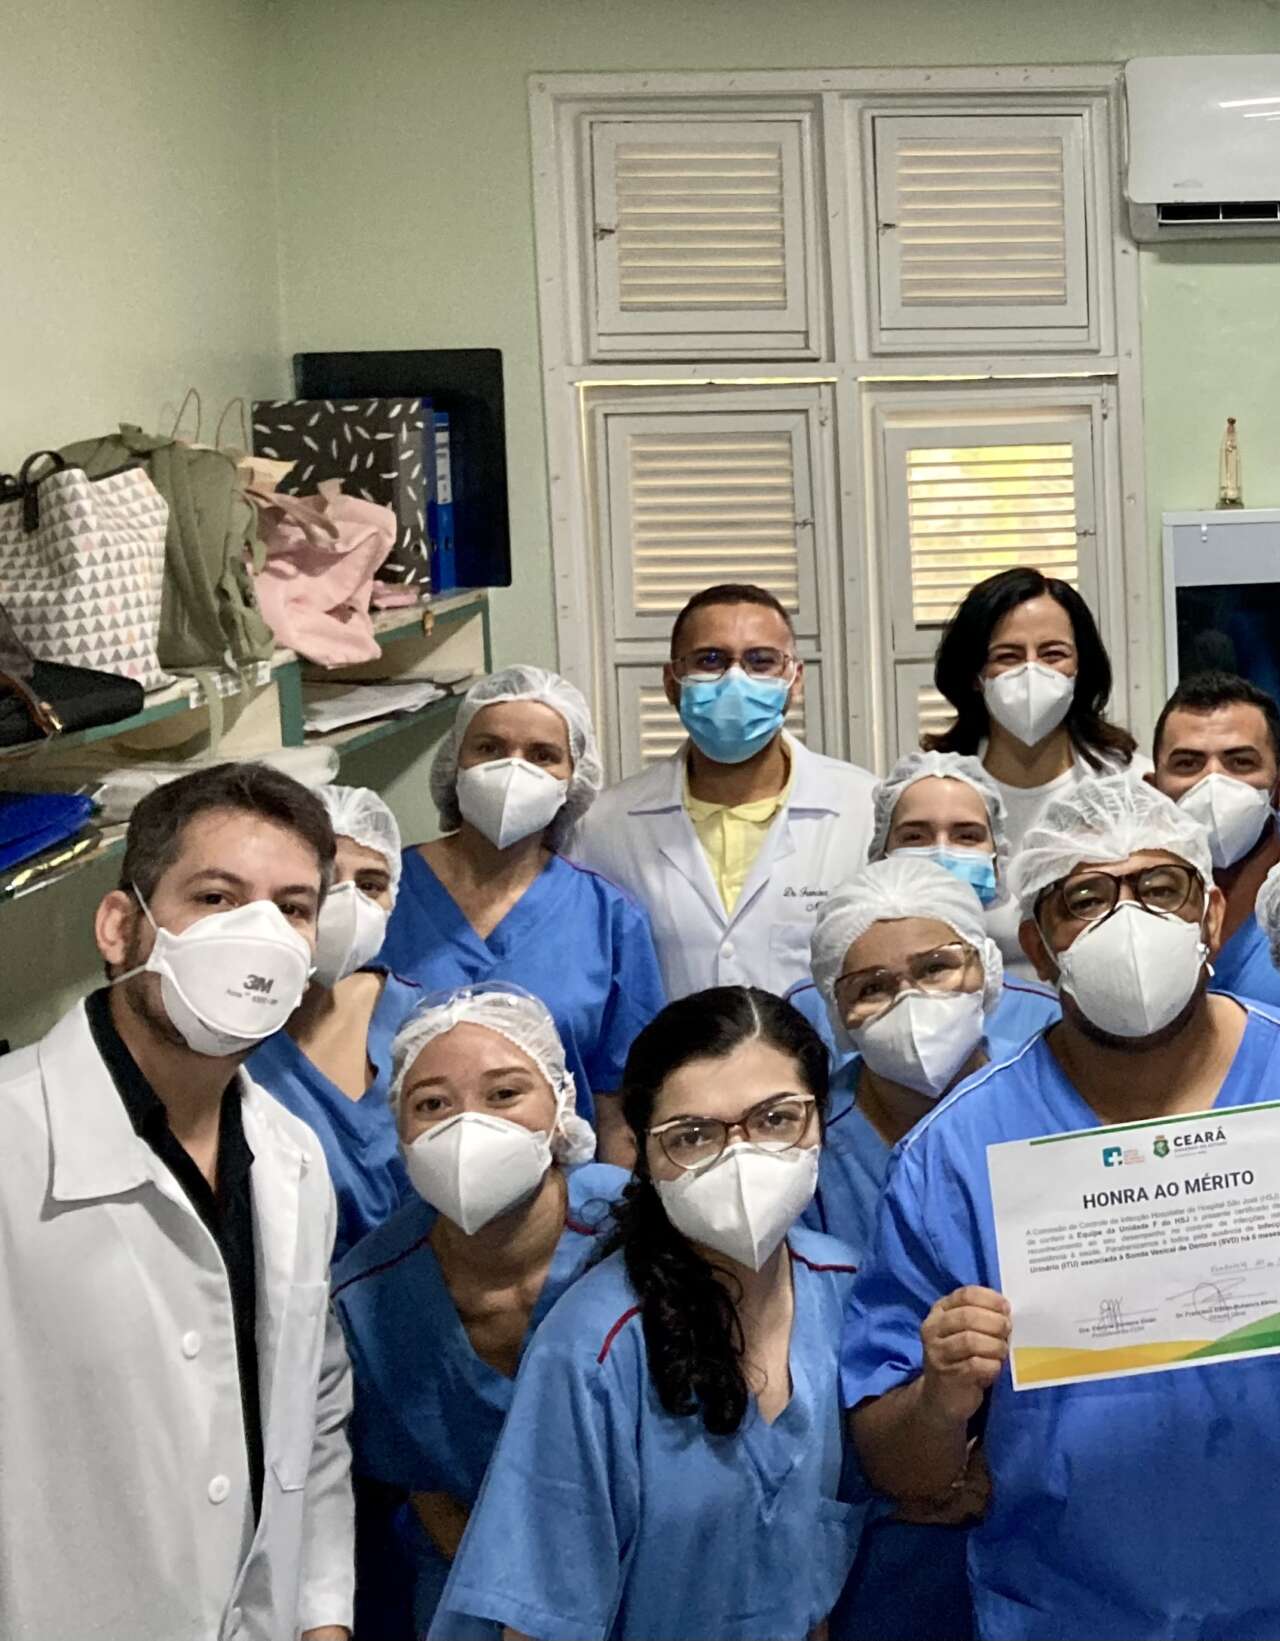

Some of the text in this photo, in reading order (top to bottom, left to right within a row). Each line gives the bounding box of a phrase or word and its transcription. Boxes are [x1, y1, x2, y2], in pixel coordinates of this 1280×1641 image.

[243, 974, 274, 994] 3M
[1173, 1126, 1226, 1147] CEARÁ
[1083, 1170, 1255, 1209] HONRA AO MÉRITO
